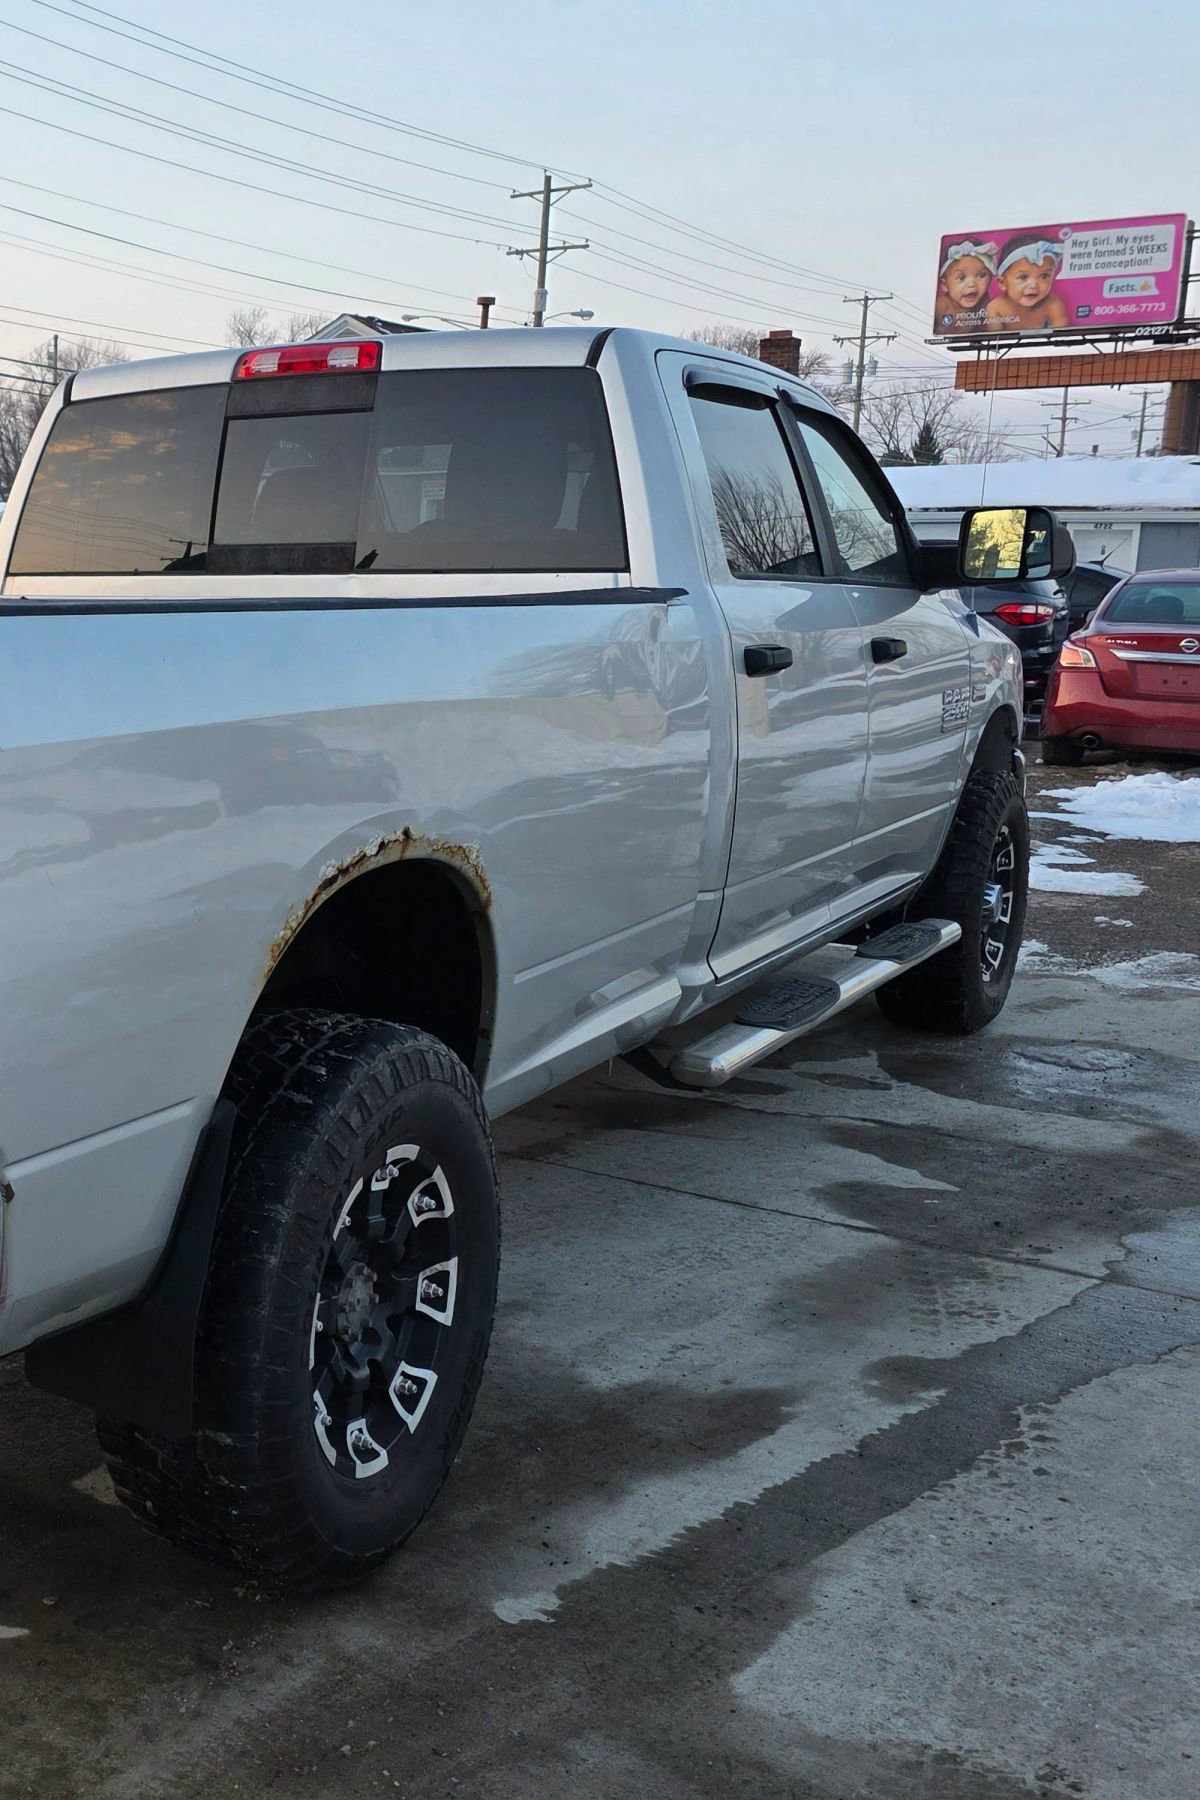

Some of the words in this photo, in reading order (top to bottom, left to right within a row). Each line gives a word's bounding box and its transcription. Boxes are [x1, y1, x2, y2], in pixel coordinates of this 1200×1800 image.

[1071, 239, 1089, 249] Hey
[1092, 237, 1112, 246] Girl.
[1116, 235, 1128, 246] My
[1132, 234, 1155, 244] eyes
[1070, 251, 1092, 260] were
[1094, 248, 1126, 258] formed
[1129, 246, 1134, 255] 5
[1137, 243, 1168, 254] WEEKS
[1069, 262, 1092, 271] from
[1094, 257, 1153, 269] conception!
[1108, 283, 1137, 293] Facts.
[1094, 302, 1165, 315] 800-366-7773
